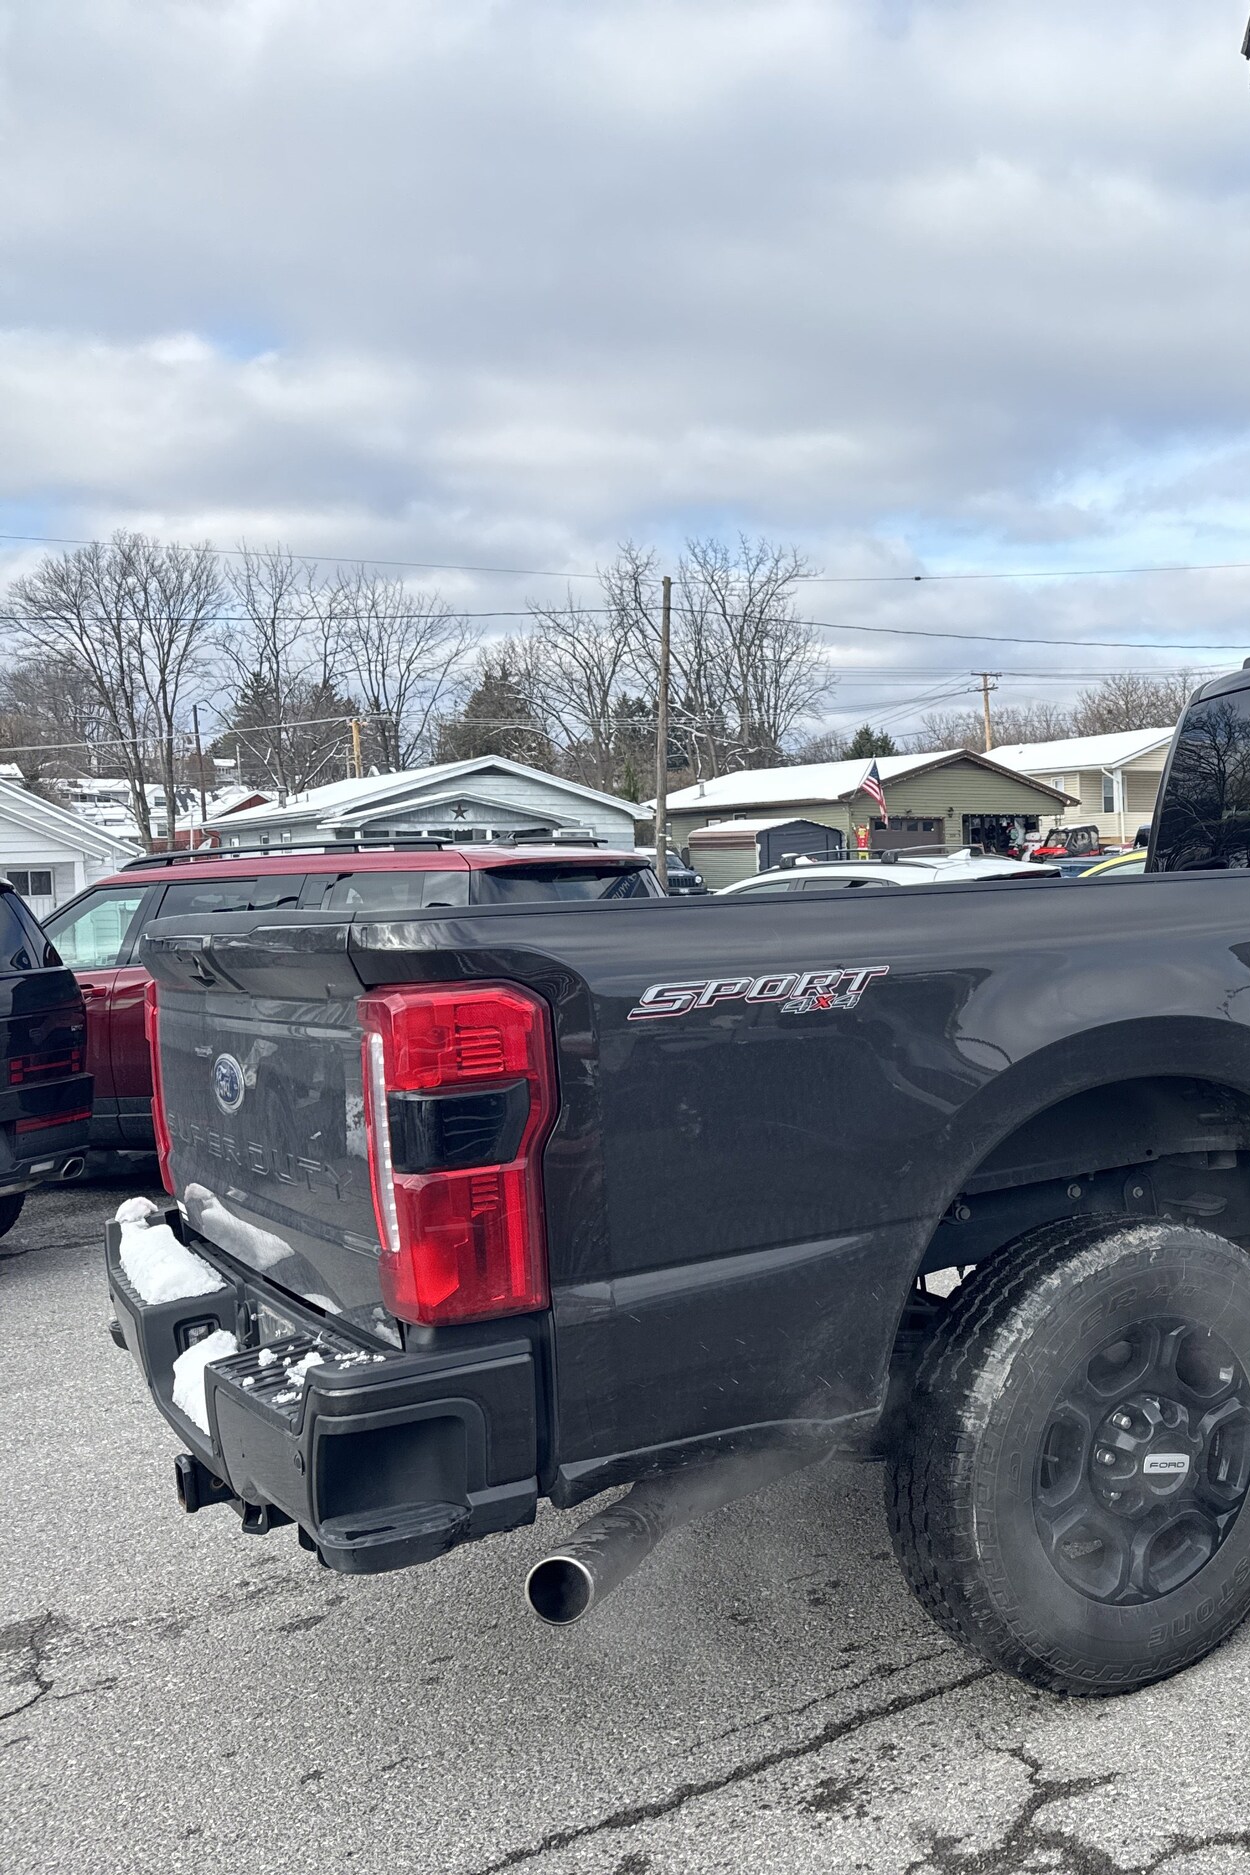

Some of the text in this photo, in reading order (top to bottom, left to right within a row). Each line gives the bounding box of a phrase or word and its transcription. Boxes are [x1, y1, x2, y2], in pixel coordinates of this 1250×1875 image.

[627, 965, 890, 1021] SPORT
[781, 993, 861, 1014] 4x4
[168, 1113, 352, 1202] SUPER DUTY
[1149, 1461, 1186, 1469] FORD
